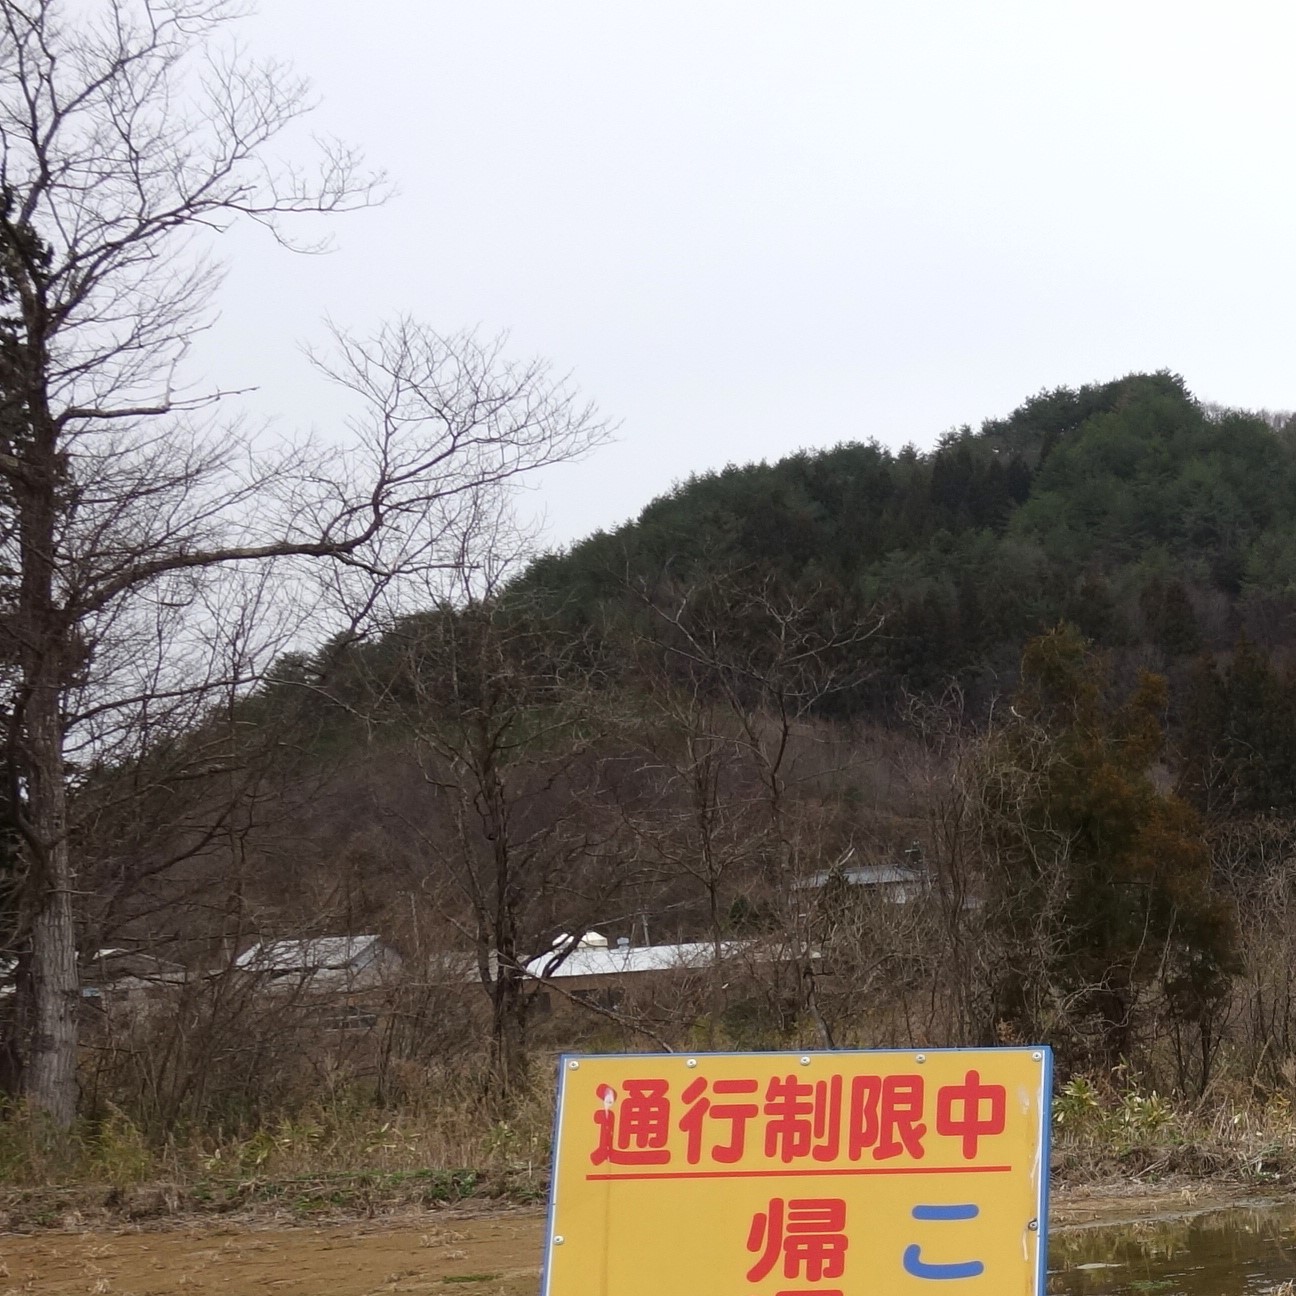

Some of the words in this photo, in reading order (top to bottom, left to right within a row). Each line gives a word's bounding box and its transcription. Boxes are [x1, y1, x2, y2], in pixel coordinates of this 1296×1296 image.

[590, 1070, 1006, 1166] 通行制限中
